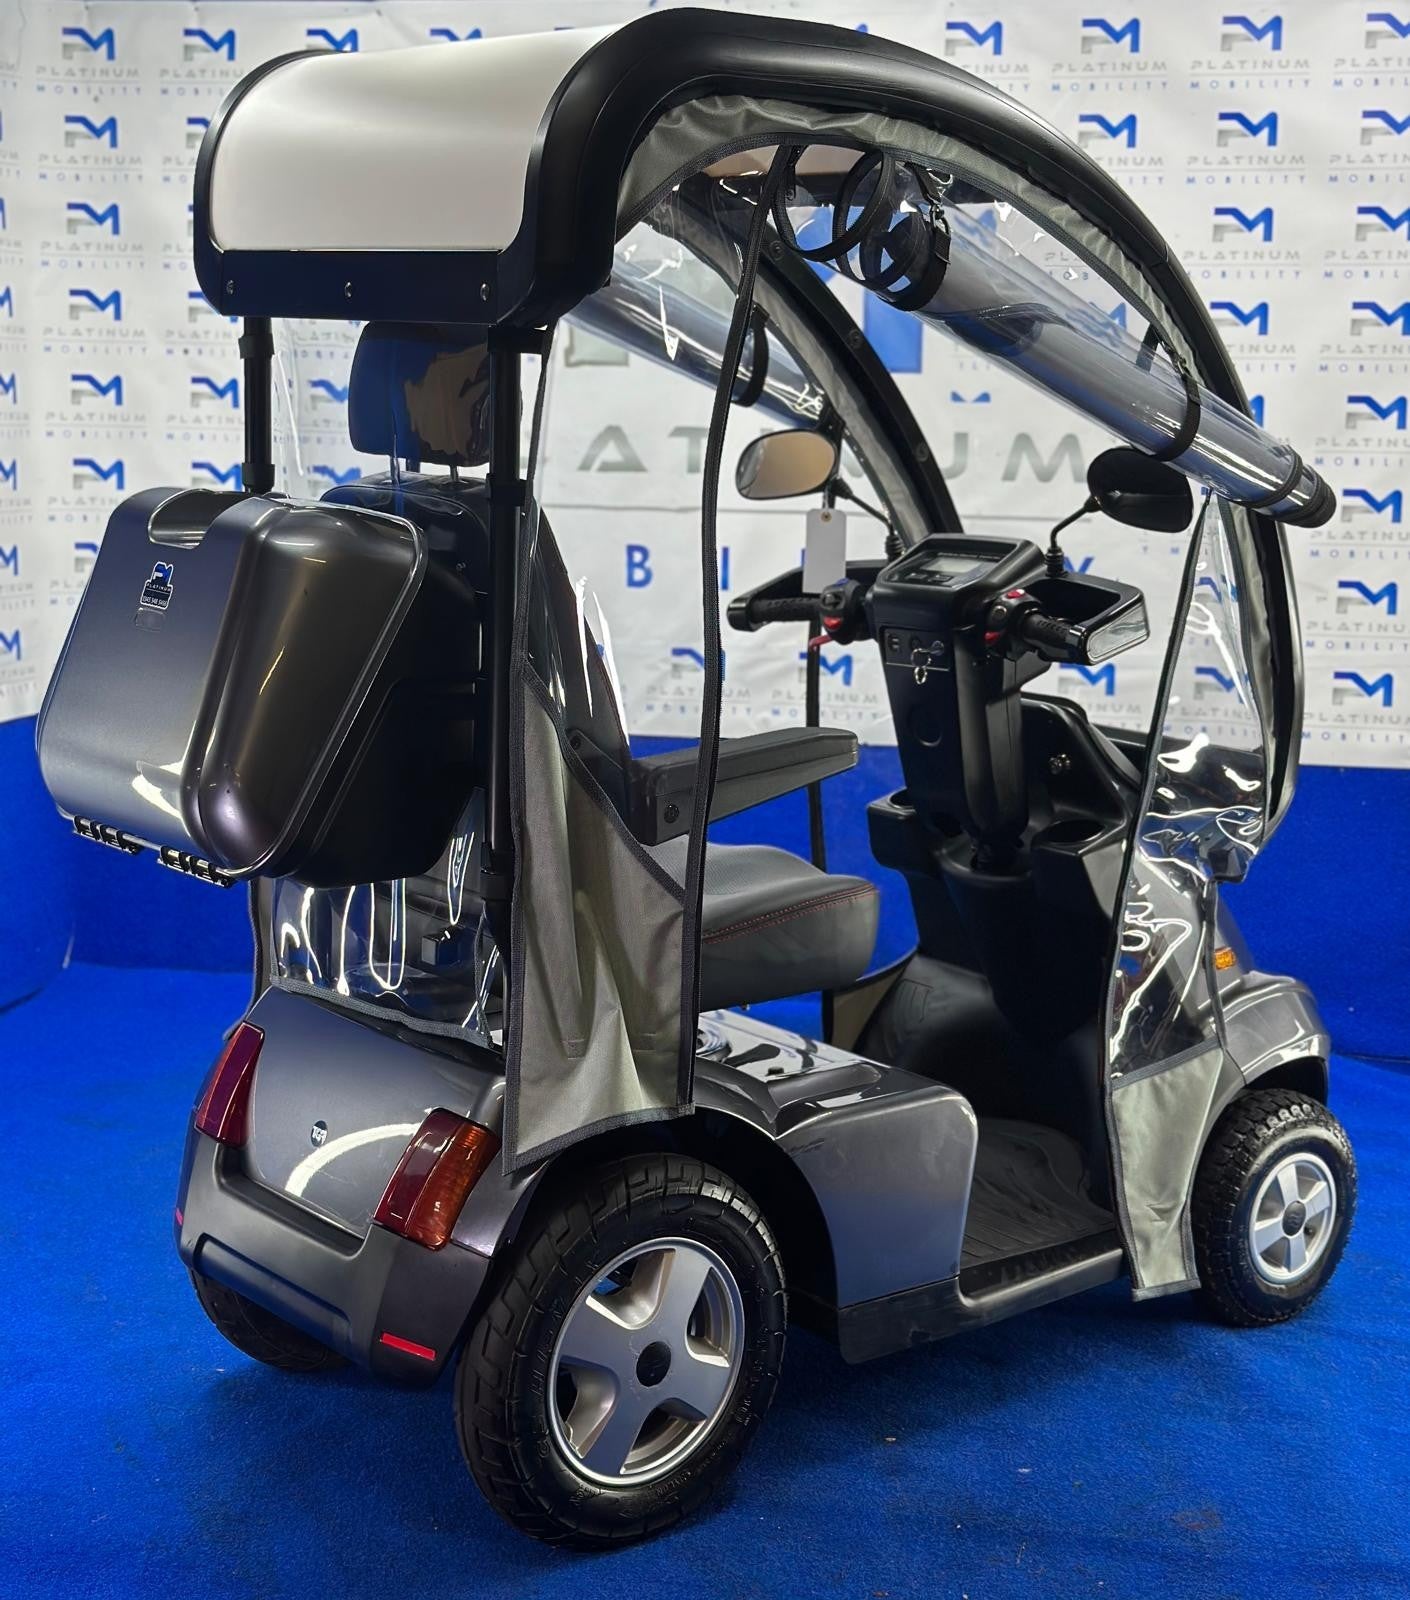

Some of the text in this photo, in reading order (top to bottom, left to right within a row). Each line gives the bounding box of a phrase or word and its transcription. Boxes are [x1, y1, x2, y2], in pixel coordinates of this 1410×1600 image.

[965, 63, 1029, 73] TINUM
[1052, 61, 1167, 72] PLATINUM
[1190, 58, 1310, 70] PLATINUM
[36, 66, 140, 78] PLATINUM
[160, 68, 244, 79] PLATINU
[1052, 82, 1168, 92] MOBILITY
[1190, 79, 1310, 90] MOBILITY
[1333, 77, 1410, 88] MOBIL
[36, 83, 141, 95] MOBILITY
[39, 153, 143, 165] PLATINUM
[1095, 156, 1164, 166] TINUM
[1187, 154, 1305, 166] PLATINUM
[39, 171, 143, 183] MOBILITY
[1186, 174, 1305, 185] MOBILITY
[1328, 174, 1406, 184] MOBIL
[41, 241, 146, 252] PLATINUM
[1183, 250, 1300, 261] PLATINUM
[1324, 250, 1410, 260] PLATIN
[41, 258, 145, 270] MOBILITY
[1323, 270, 1400, 280] MOBIL
[43, 327, 146, 338] PLATINUM
[166, 330, 238, 341] PLATIN
[44, 344, 147, 355] MOBILITY
[1226, 343, 1296, 354] TINUM
[1319, 363, 1408, 373] MOBILI
[45, 411, 146, 423] PLATINUM
[167, 414, 245, 425] PLATINU
[46, 428, 147, 440] MOBILITY
[1315, 437, 1410, 448] PLATINU
[1315, 456, 1404, 467] MOBILI
[48, 495, 119, 507] PLATIN
[1310, 530, 1410, 541] PLATINU
[1307, 620, 1408, 633] PLATINU
[1306, 639, 1410, 651] MOBILIT
[647, 686, 750, 699] PLATUM
[772, 708, 879, 721] MOILITY
[1302, 731, 1403, 743] MOBILIT
